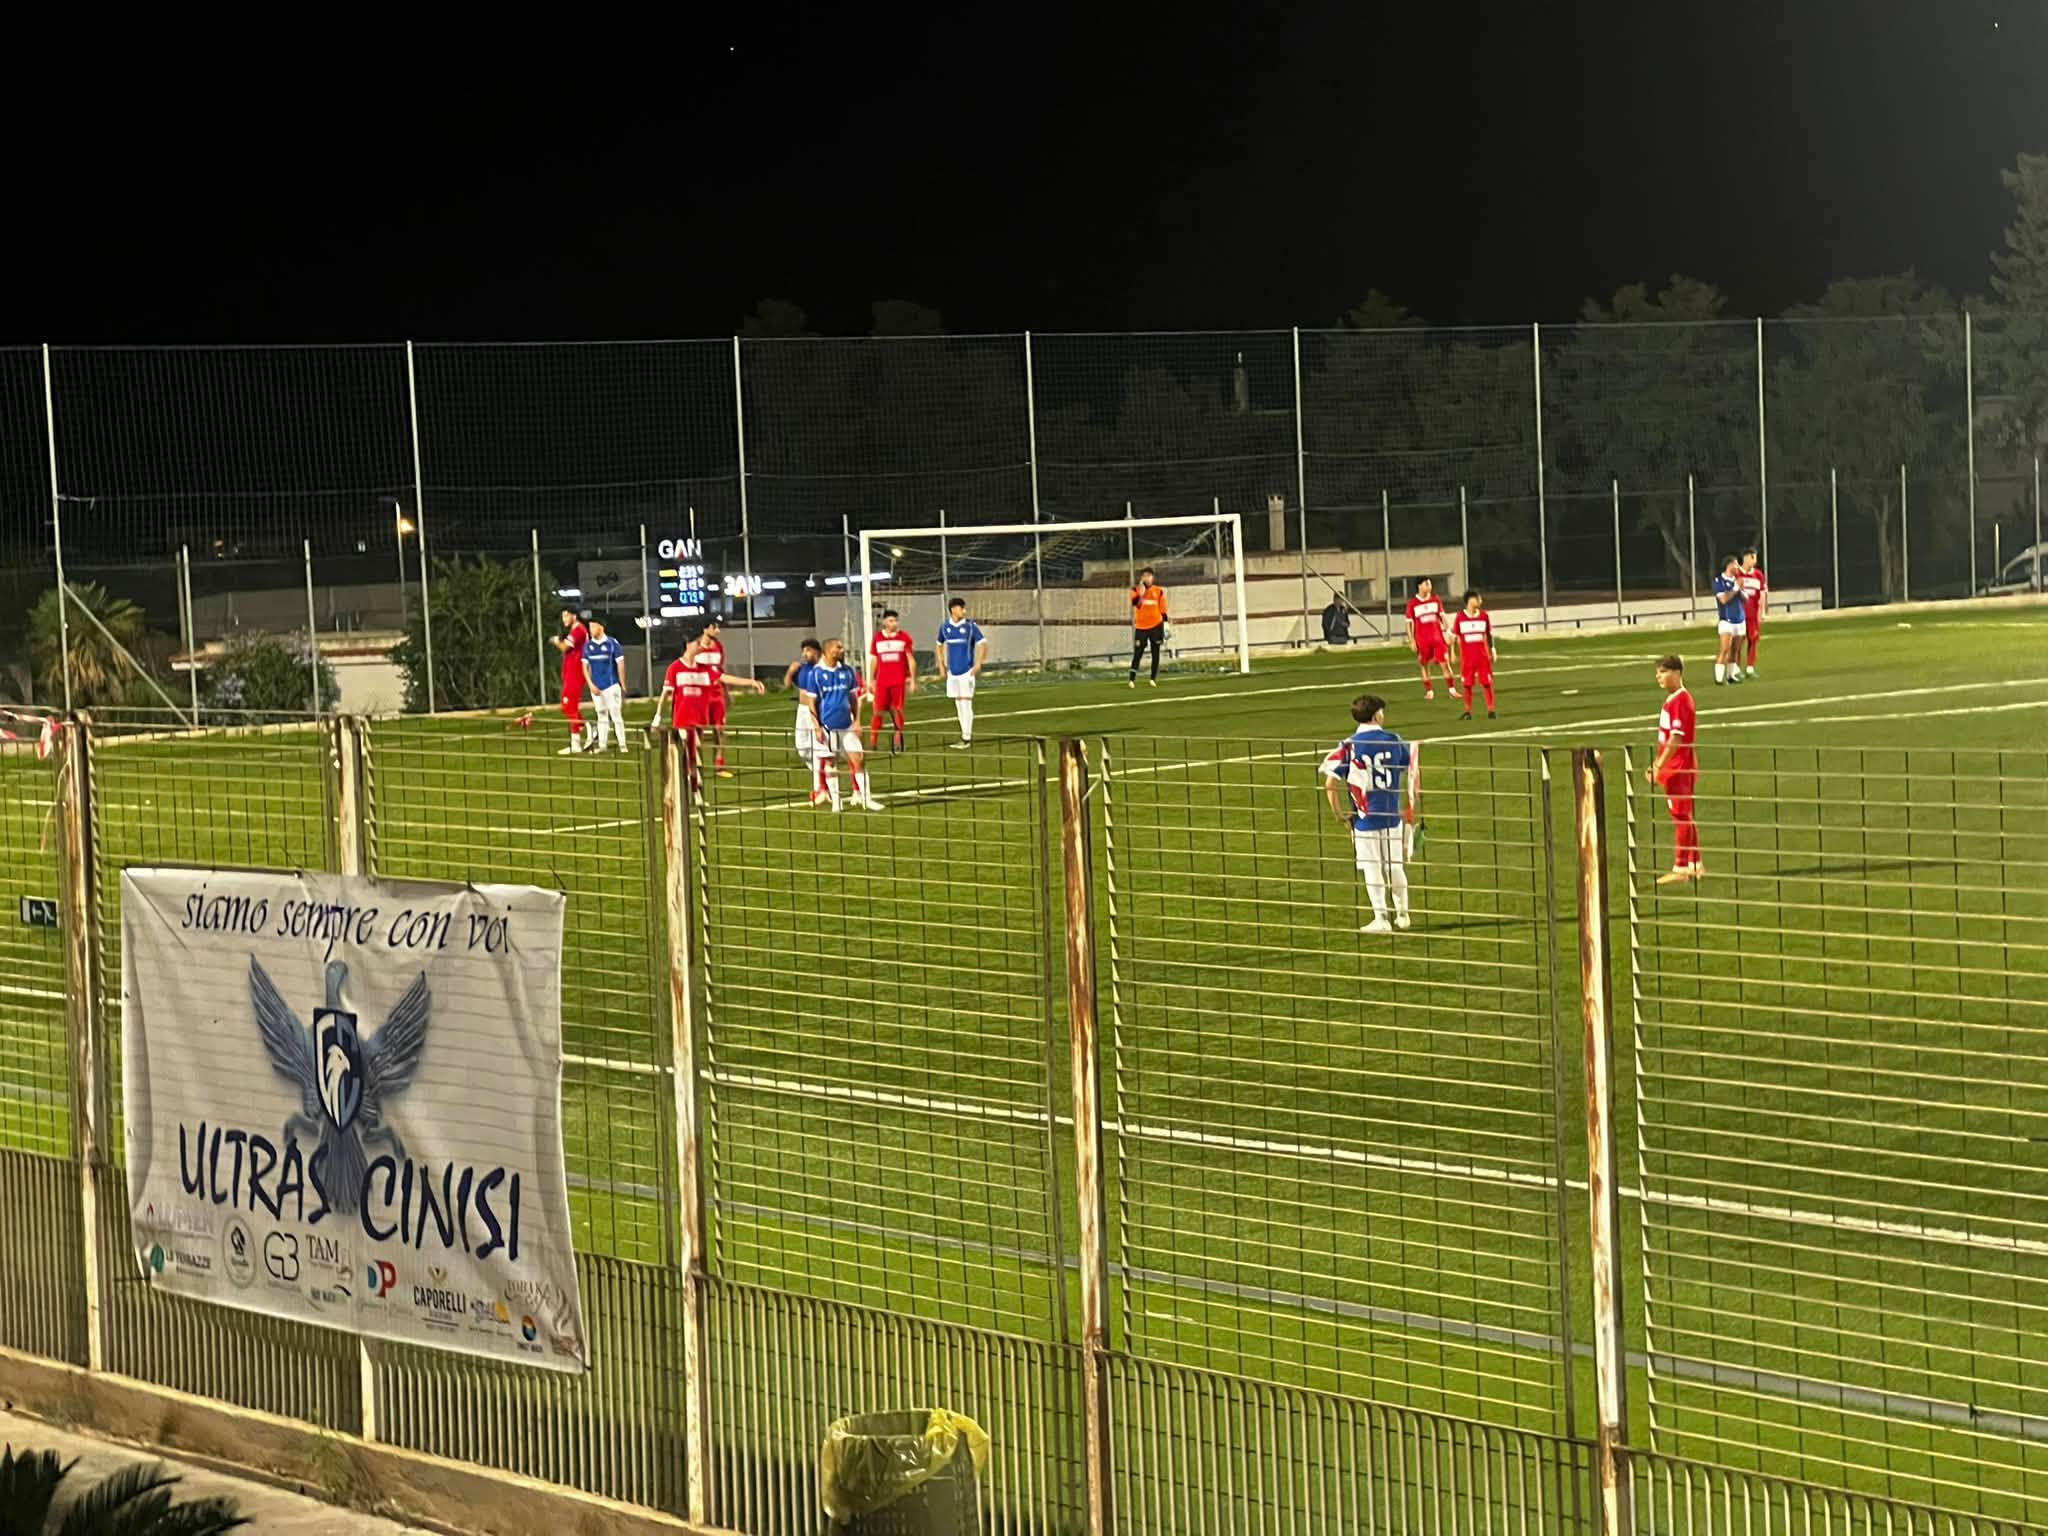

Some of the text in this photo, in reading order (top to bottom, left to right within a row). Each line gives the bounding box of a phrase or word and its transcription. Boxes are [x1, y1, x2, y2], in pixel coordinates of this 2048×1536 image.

[182, 883, 512, 963] siamo sempre con voi
[179, 1121, 520, 1261] ULTRAS CINISI
[413, 1286, 466, 1314] CAPORELLI
